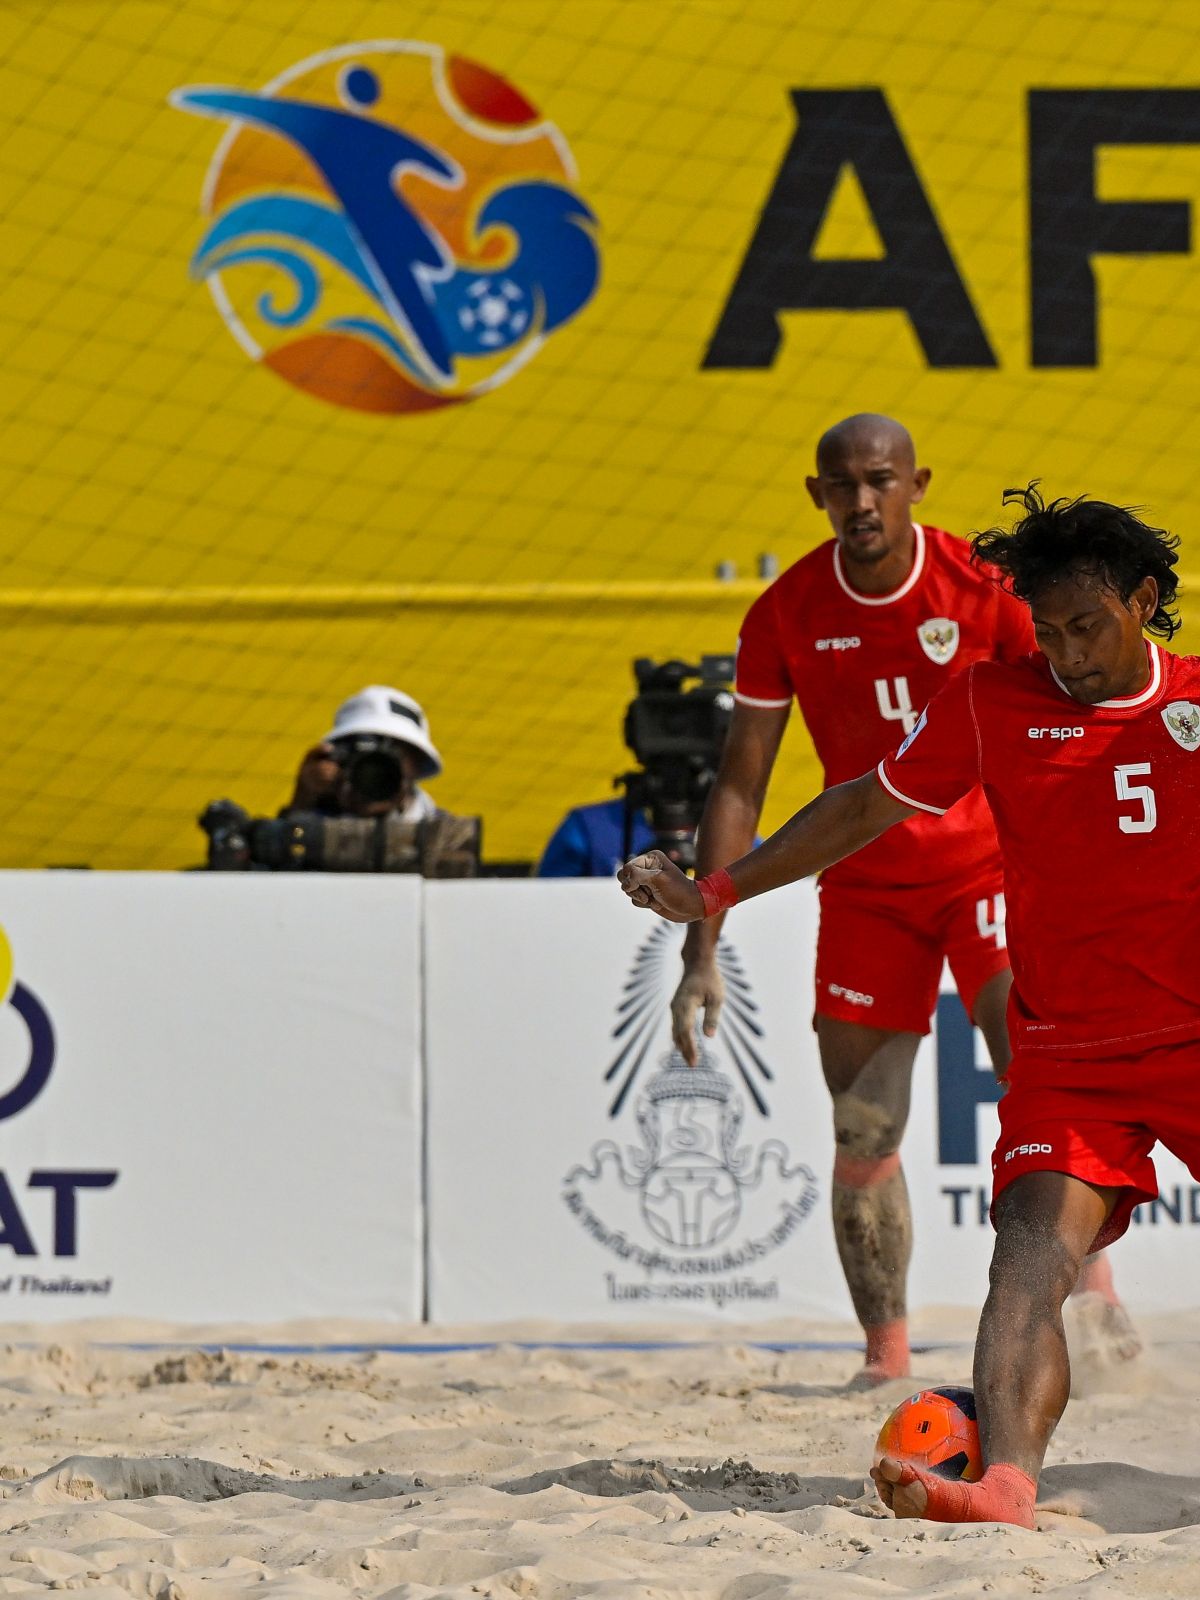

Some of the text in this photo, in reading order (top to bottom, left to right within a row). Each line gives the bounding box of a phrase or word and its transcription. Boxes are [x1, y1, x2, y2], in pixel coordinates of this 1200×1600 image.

[815, 636, 861, 652] erspo
[874, 676, 919, 735] 4
[1028, 727, 1084, 740] erspo
[1114, 762, 1157, 834] 5
[976, 892, 1007, 950] 4
[829, 983, 874, 1008] erspo
[1005, 1143, 1052, 1162] erspo
[21, 1275, 113, 1295] Thailand
